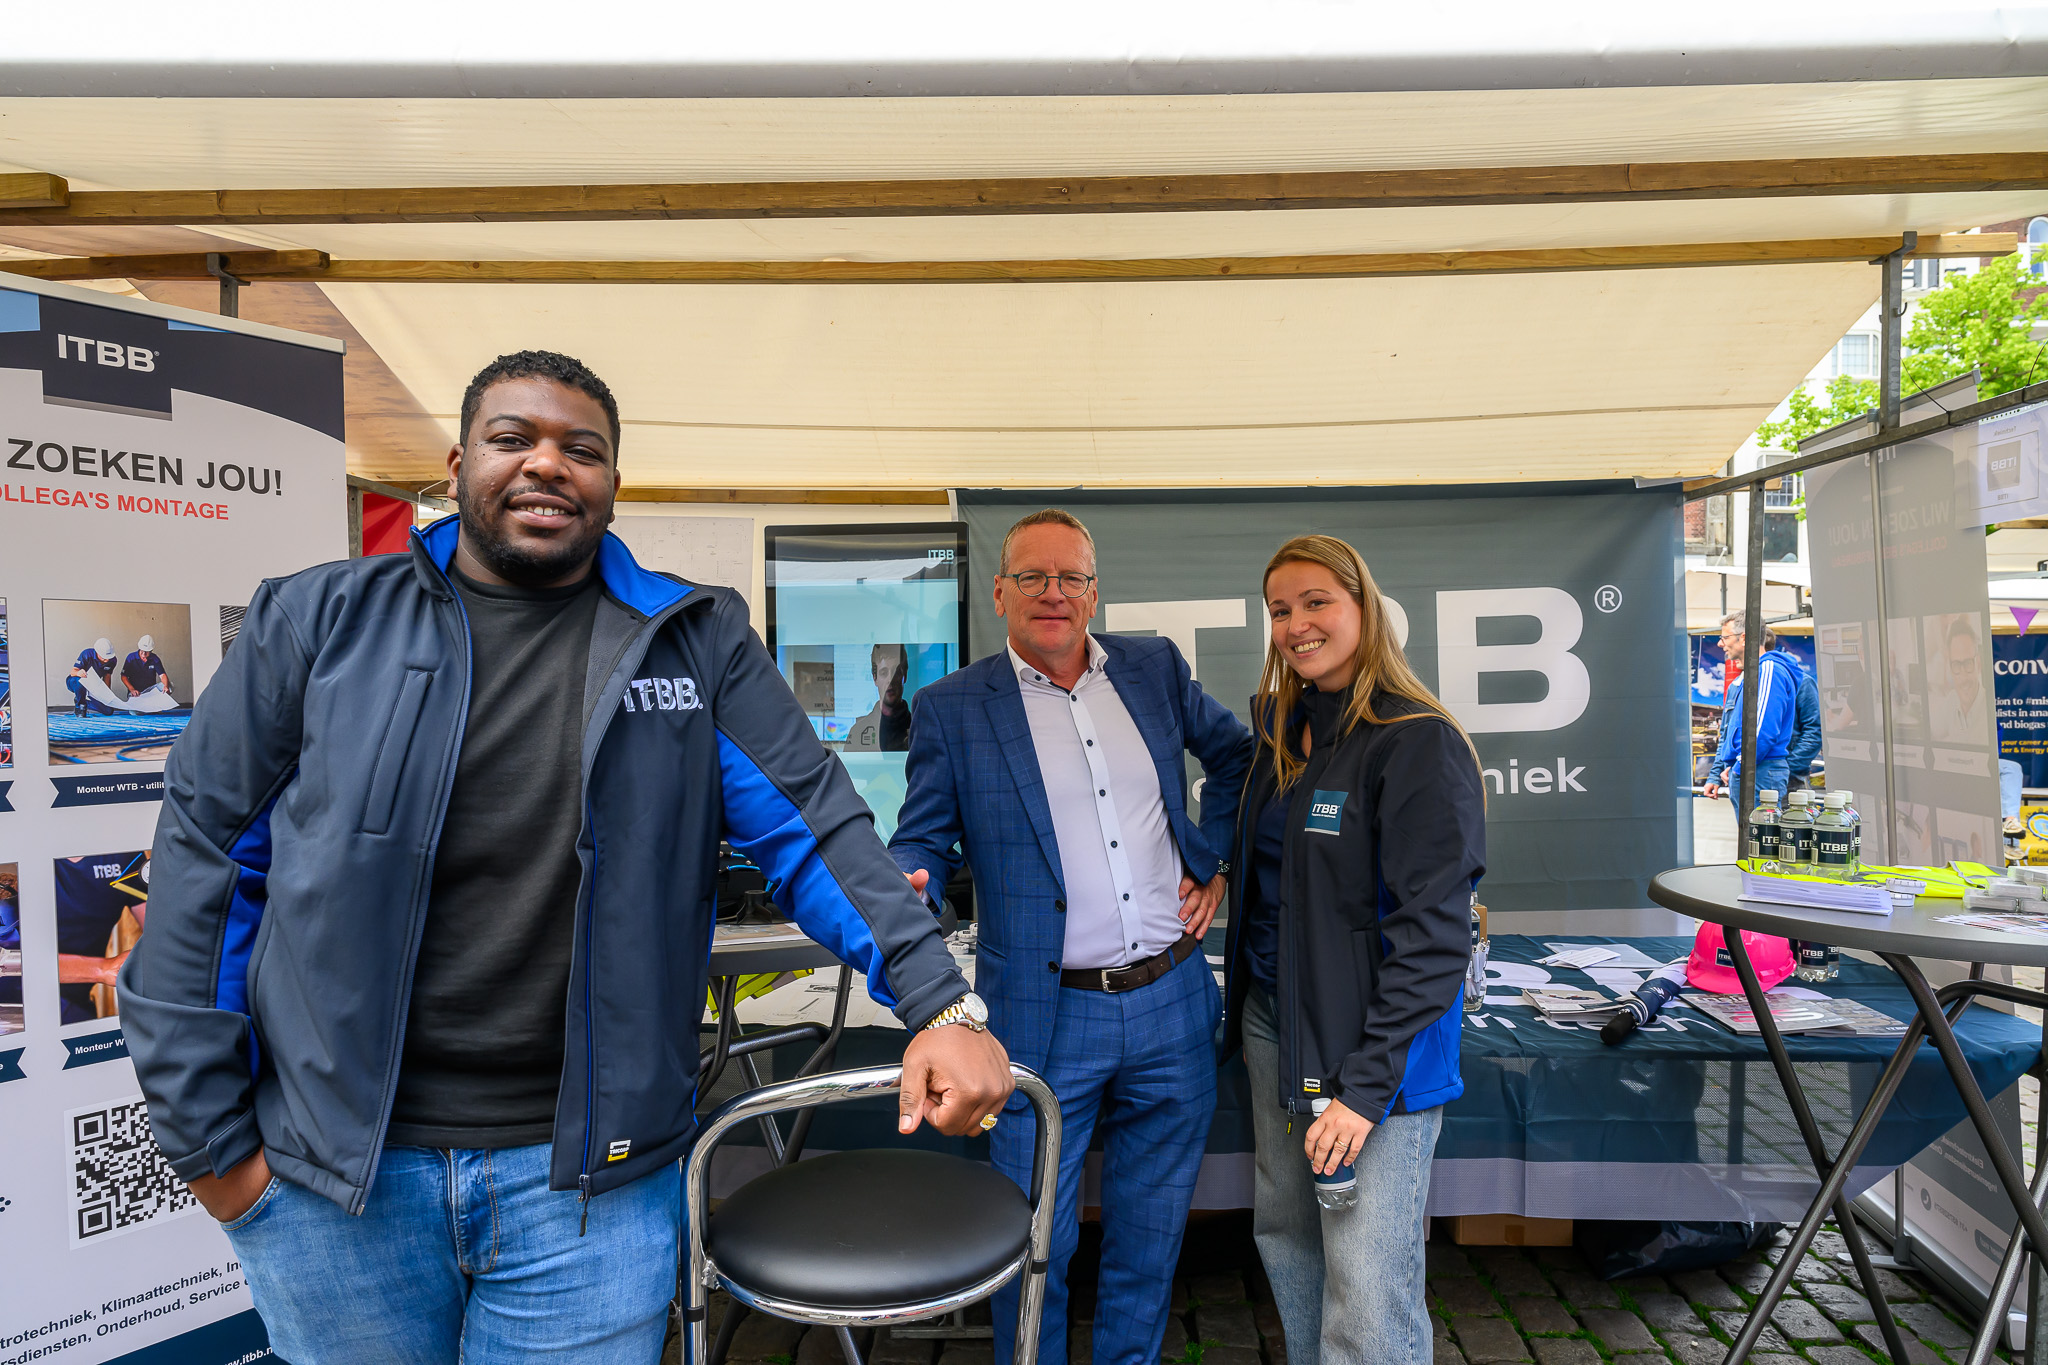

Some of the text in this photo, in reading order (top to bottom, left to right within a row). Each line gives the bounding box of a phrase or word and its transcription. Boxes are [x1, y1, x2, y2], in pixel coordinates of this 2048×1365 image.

[6, 437, 283, 497] ZOEKEN JOU!
[117, 494, 230, 521] MONTAGE
[928, 549, 955, 561] ITBB
[2012, 698, 2024, 706] to
[2018, 708, 2028, 717] in
[2014, 720, 2046, 731] biogas
[76, 785, 115, 794] Monteur
[116, 782, 138, 792] WTB
[1820, 842, 1848, 852] ITBB
[93, 863, 121, 879] ITBB
[1802, 948, 1824, 957] ITBB
[75, 1040, 114, 1055] Monteur
[0, 1309, 96, 1350] trotechniek,
[101, 1265, 223, 1316] Klimaattechniek,
[96, 1297, 185, 1337] Onderhoud,
[188, 1280, 240, 1306] Service
